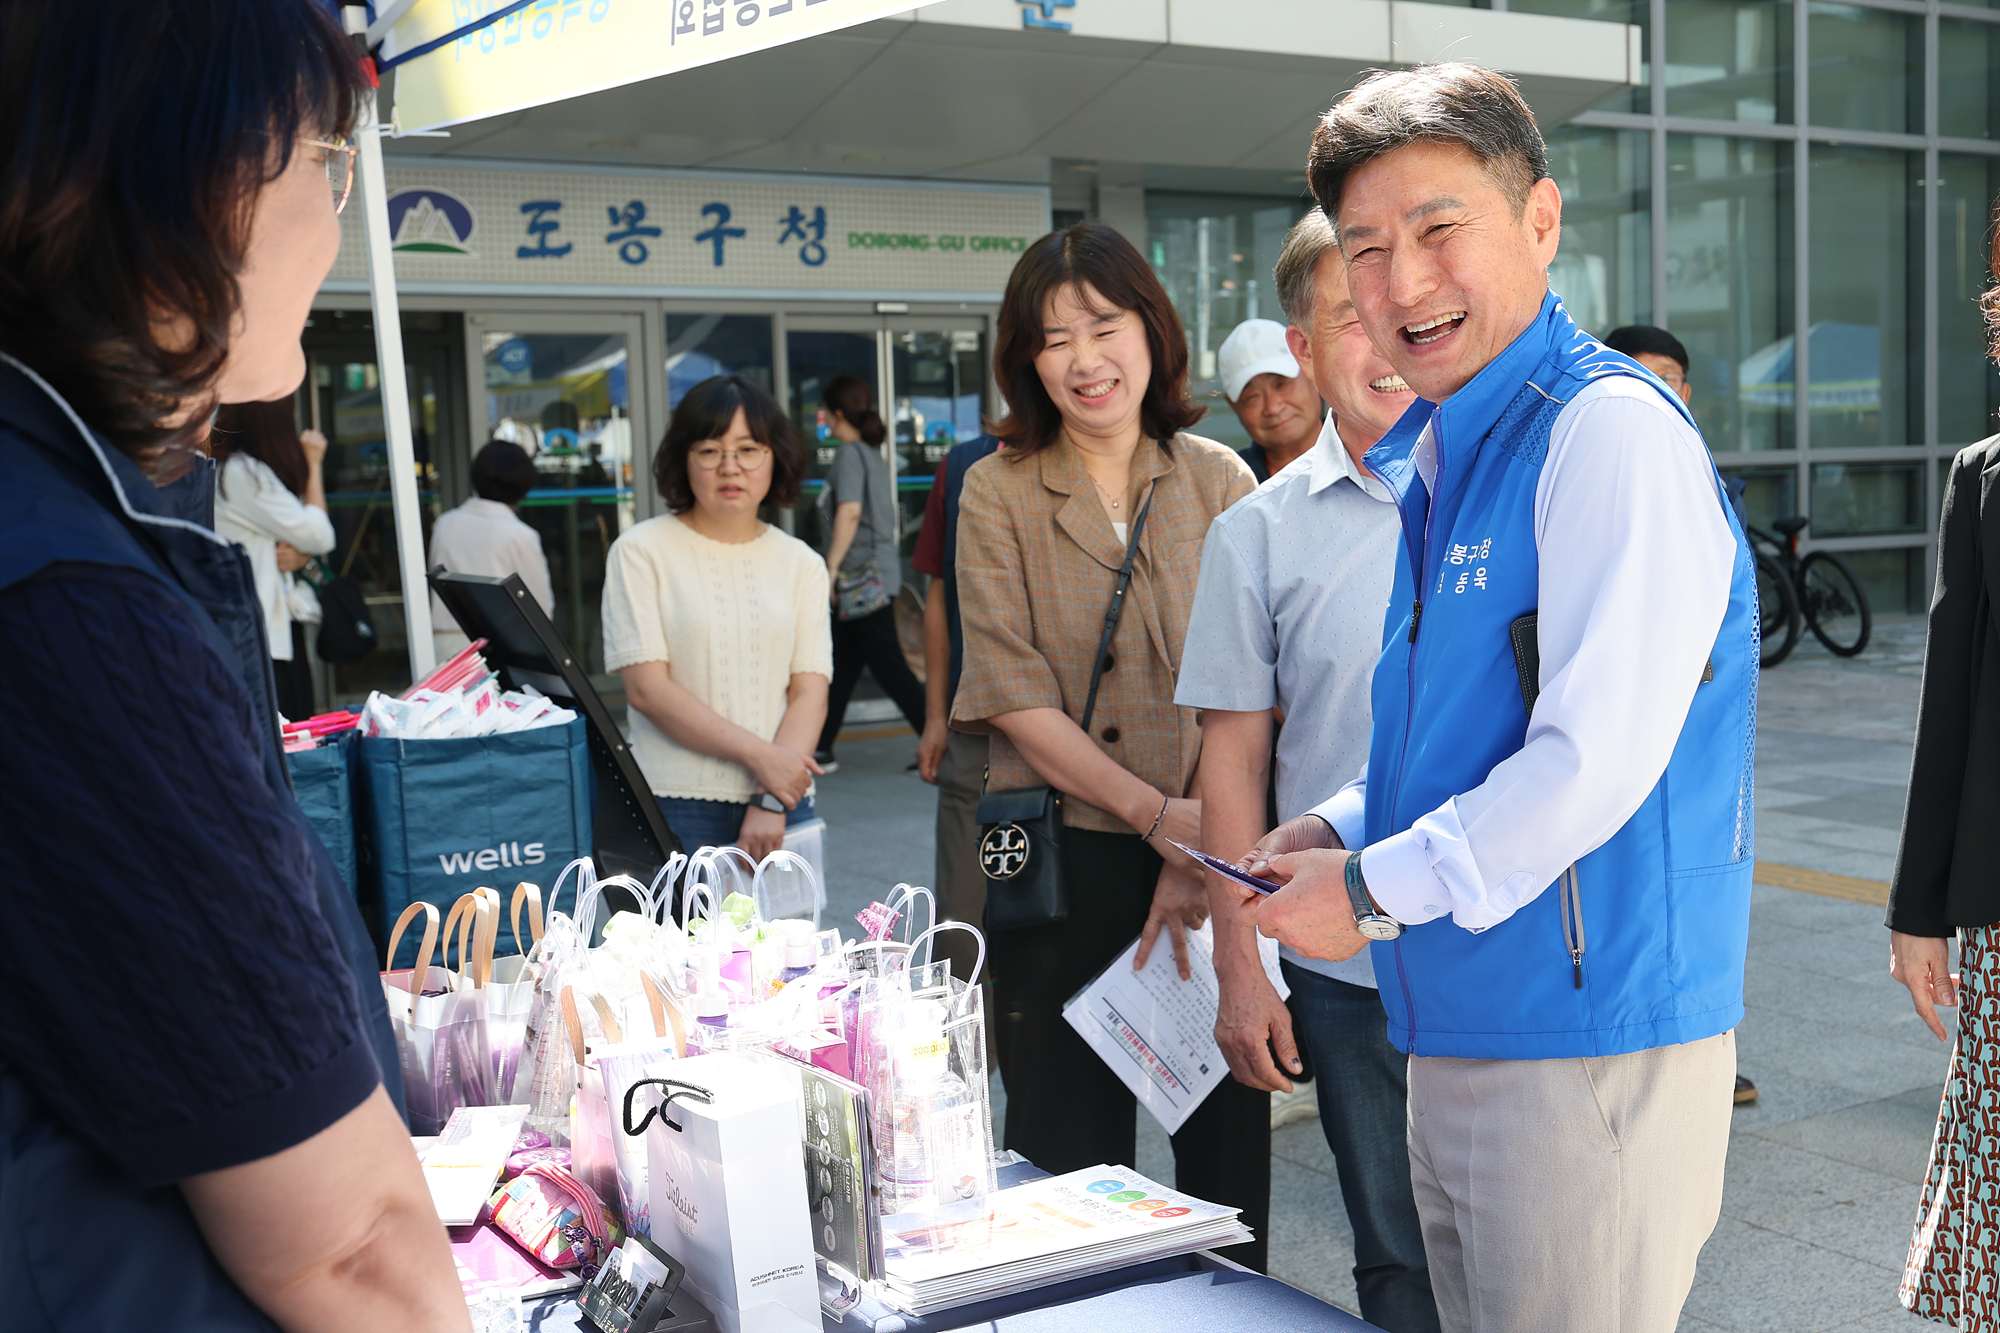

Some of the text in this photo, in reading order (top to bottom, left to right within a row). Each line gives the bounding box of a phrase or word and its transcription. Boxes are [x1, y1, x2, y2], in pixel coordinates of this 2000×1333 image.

[516, 200, 827, 266] 도봉구청
[848, 231, 1027, 253] DOBONG-GU OFFICE
[438, 842, 547, 875] wells
[1106, 1010, 1121, 1027] 개최
[913, 1042, 946, 1056] 200,000
[1112, 1167, 1145, 1186] STORE
[782, 1264, 804, 1273] KOREA
